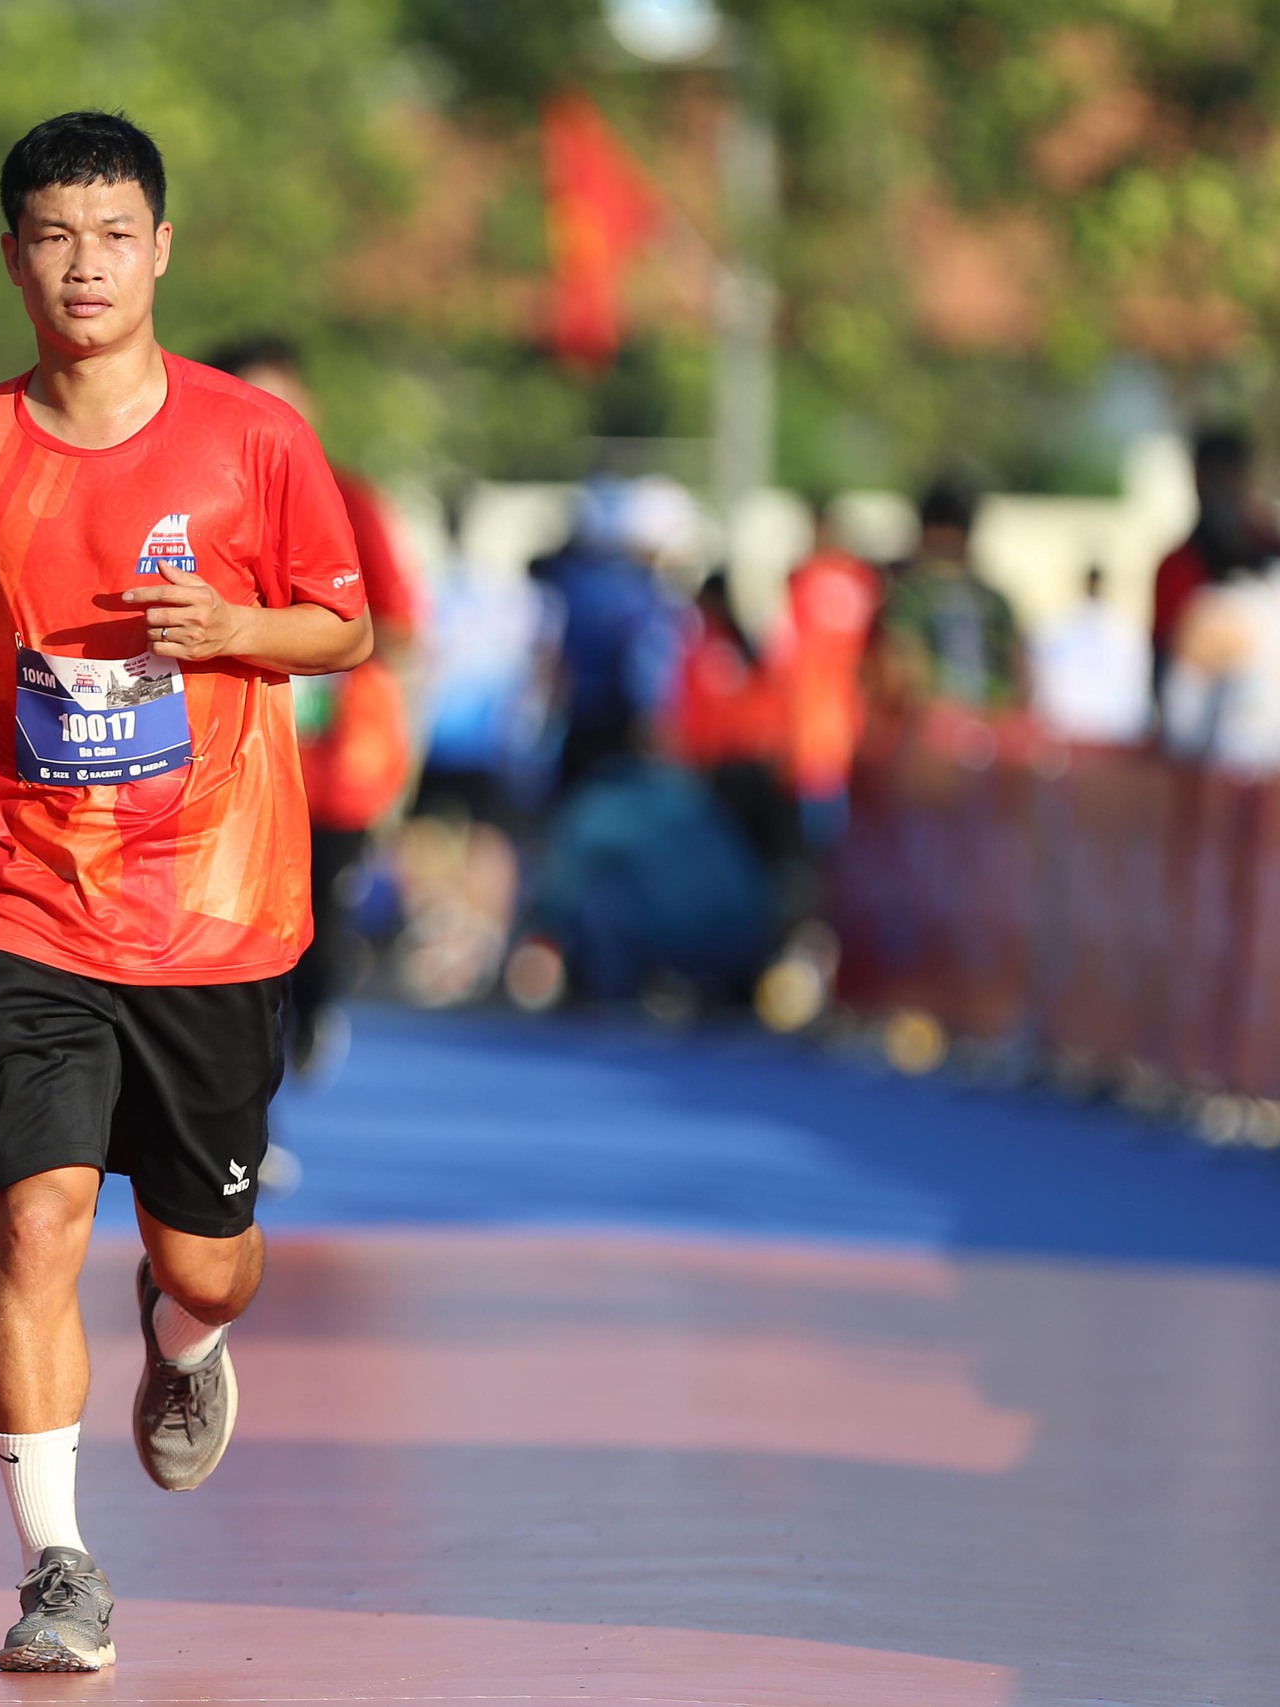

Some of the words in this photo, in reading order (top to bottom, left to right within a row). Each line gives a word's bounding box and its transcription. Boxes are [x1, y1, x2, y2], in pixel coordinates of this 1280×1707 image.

[22, 666, 57, 689] 10KM
[58, 710, 136, 743] 10017
[79, 747, 93, 758] Ba
[94, 746, 116, 757] Cam
[52, 771, 70, 779] SIZE
[89, 769, 123, 779] RACEKIT
[142, 760, 169, 773] MEDAL
